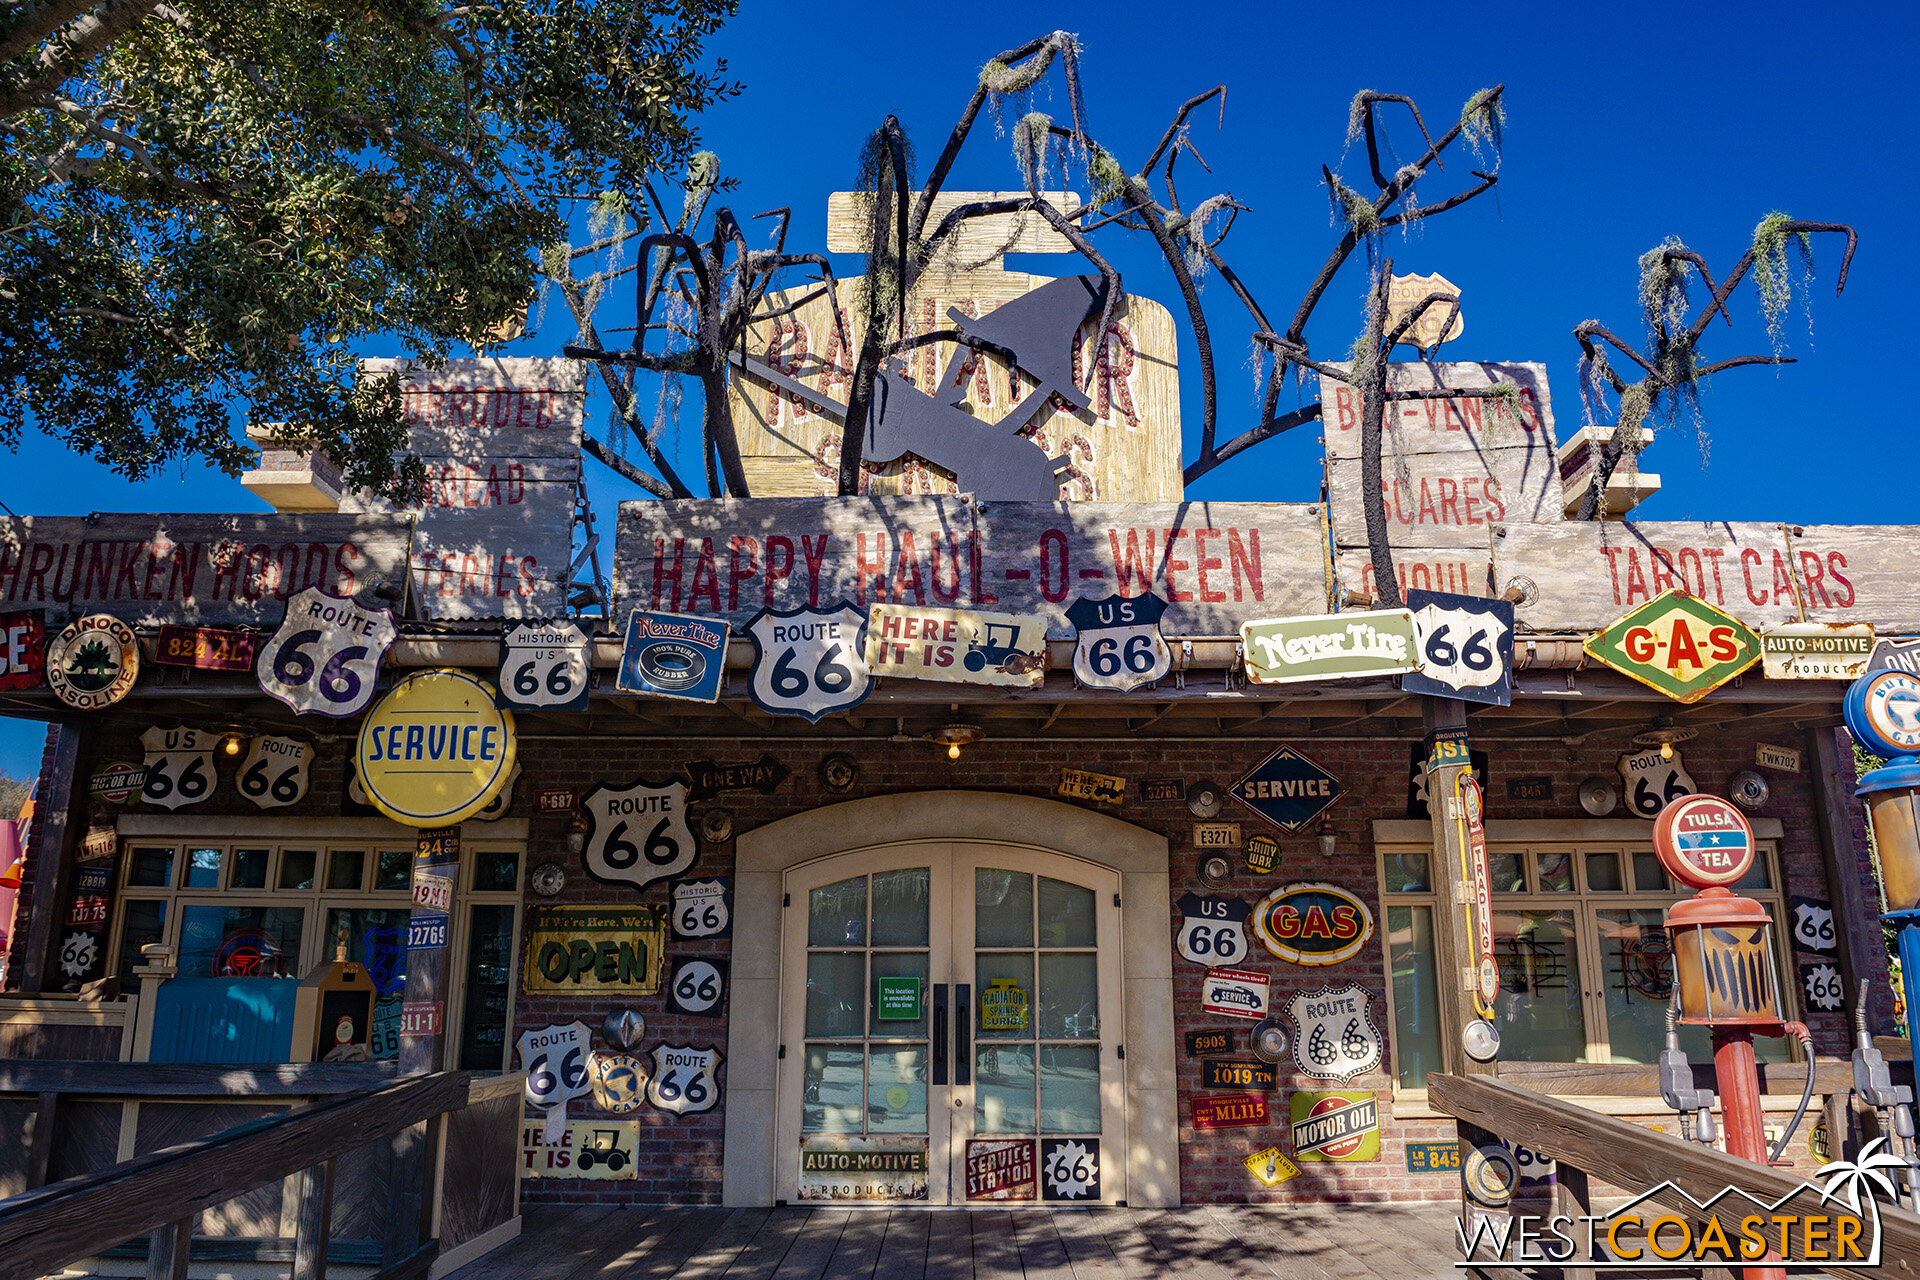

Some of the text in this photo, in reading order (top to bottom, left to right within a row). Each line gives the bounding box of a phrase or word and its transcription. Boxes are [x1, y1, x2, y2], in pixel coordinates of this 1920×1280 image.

[1391, 287, 1439, 299] ROUT
[386, 384, 555, 430] ORRODED
[211, 541, 358, 602] HOODS
[411, 552, 537, 598] TERIES
[651, 527, 1265, 612] HAPPY HAUL-O-WEEN
[1600, 546, 1856, 609] TAROT CARS
[308, 600, 379, 638] ROUTE
[1097, 603, 1135, 624] US
[61, 617, 133, 645] DINOCO
[518, 632, 575, 645] HISTORIC
[634, 616, 721, 647] Never Tire
[773, 622, 840, 643] ROUTE
[881, 615, 958, 643] HERE
[168, 638, 243, 661] 824 AL
[652, 644, 698, 657] 100% PURE
[879, 642, 955, 667] IT IS
[1089, 634, 1155, 676] 66
[1254, 622, 1407, 669] Never Tire
[1427, 623, 1493, 670] 66
[1624, 618, 1740, 669] G-A-S
[1767, 637, 1869, 652] AUTO-MOTIVE
[272, 629, 369, 704] 66
[652, 667, 690, 679] RUBBER
[770, 643, 853, 698] 66
[1784, 665, 1858, 674] PRODUCTS
[49, 667, 136, 709] GASOLINE
[513, 661, 574, 698] 66
[165, 731, 196, 749] US
[261, 739, 304, 758] ROUTE
[368, 724, 498, 761] SERVICE
[90, 772, 144, 790] MOTOR OIL
[143, 756, 208, 799] 66
[241, 757, 300, 802] 66
[702, 764, 775, 788] ONE WAY
[1064, 773, 1093, 786] HERE
[1063, 782, 1091, 795] IT IS
[1245, 779, 1331, 799] SERVICE
[1634, 769, 1691, 815] 66
[608, 795, 672, 816] ROUTE
[1685, 811, 1733, 827] TULSA
[603, 816, 679, 870] 66
[1201, 830, 1234, 844] E327L
[1247, 841, 1277, 856] SHINY
[1249, 852, 1272, 869] WAX
[1702, 853, 1733, 867] TEA
[680, 887, 718, 896] HISTORIC
[1474, 848, 1490, 949] TRADING
[681, 904, 719, 931] 66
[1201, 901, 1227, 917] US
[1272, 905, 1358, 939] GAS
[1801, 915, 1834, 939] 66
[1188, 926, 1236, 957] 66
[62, 942, 91, 967] 66
[538, 939, 648, 985] OPEN
[676, 972, 717, 1001] 66
[1221, 991, 1251, 1004] SERVICE
[1813, 976, 1842, 998] 66
[983, 990, 1025, 1007] RADIATOR
[1305, 998, 1356, 1019] ROUTE
[984, 1017, 1025, 1026] CURIOS
[990, 1005, 1020, 1017] SPRINGS
[371, 1030, 398, 1055] 66
[530, 1030, 577, 1049] ROUTE
[1195, 1035, 1227, 1049] 5903
[1309, 1017, 1369, 1065] 66
[528, 1047, 590, 1096] 66
[665, 1054, 707, 1068] ROUTE
[658, 1069, 707, 1103] 66
[1213, 1068, 1271, 1085] 1019 TN
[612, 1098, 640, 1112] GAS
[1216, 1103, 1265, 1120] ML115
[1295, 1104, 1374, 1149] MOTOR OIL
[1327, 1138, 1359, 1153] 100% PURE
[547, 1150, 571, 1168] IS
[806, 1153, 921, 1170] AUTO-MOTIVE
[969, 1144, 1031, 1176] SERVICE
[1053, 1155, 1090, 1184] 66
[1247, 1153, 1295, 1175] SPARK PLUGS
[1412, 1151, 1460, 1168] LR 845
[969, 1162, 1032, 1194] STATION
[821, 1185, 904, 1195] PRODUCTS
